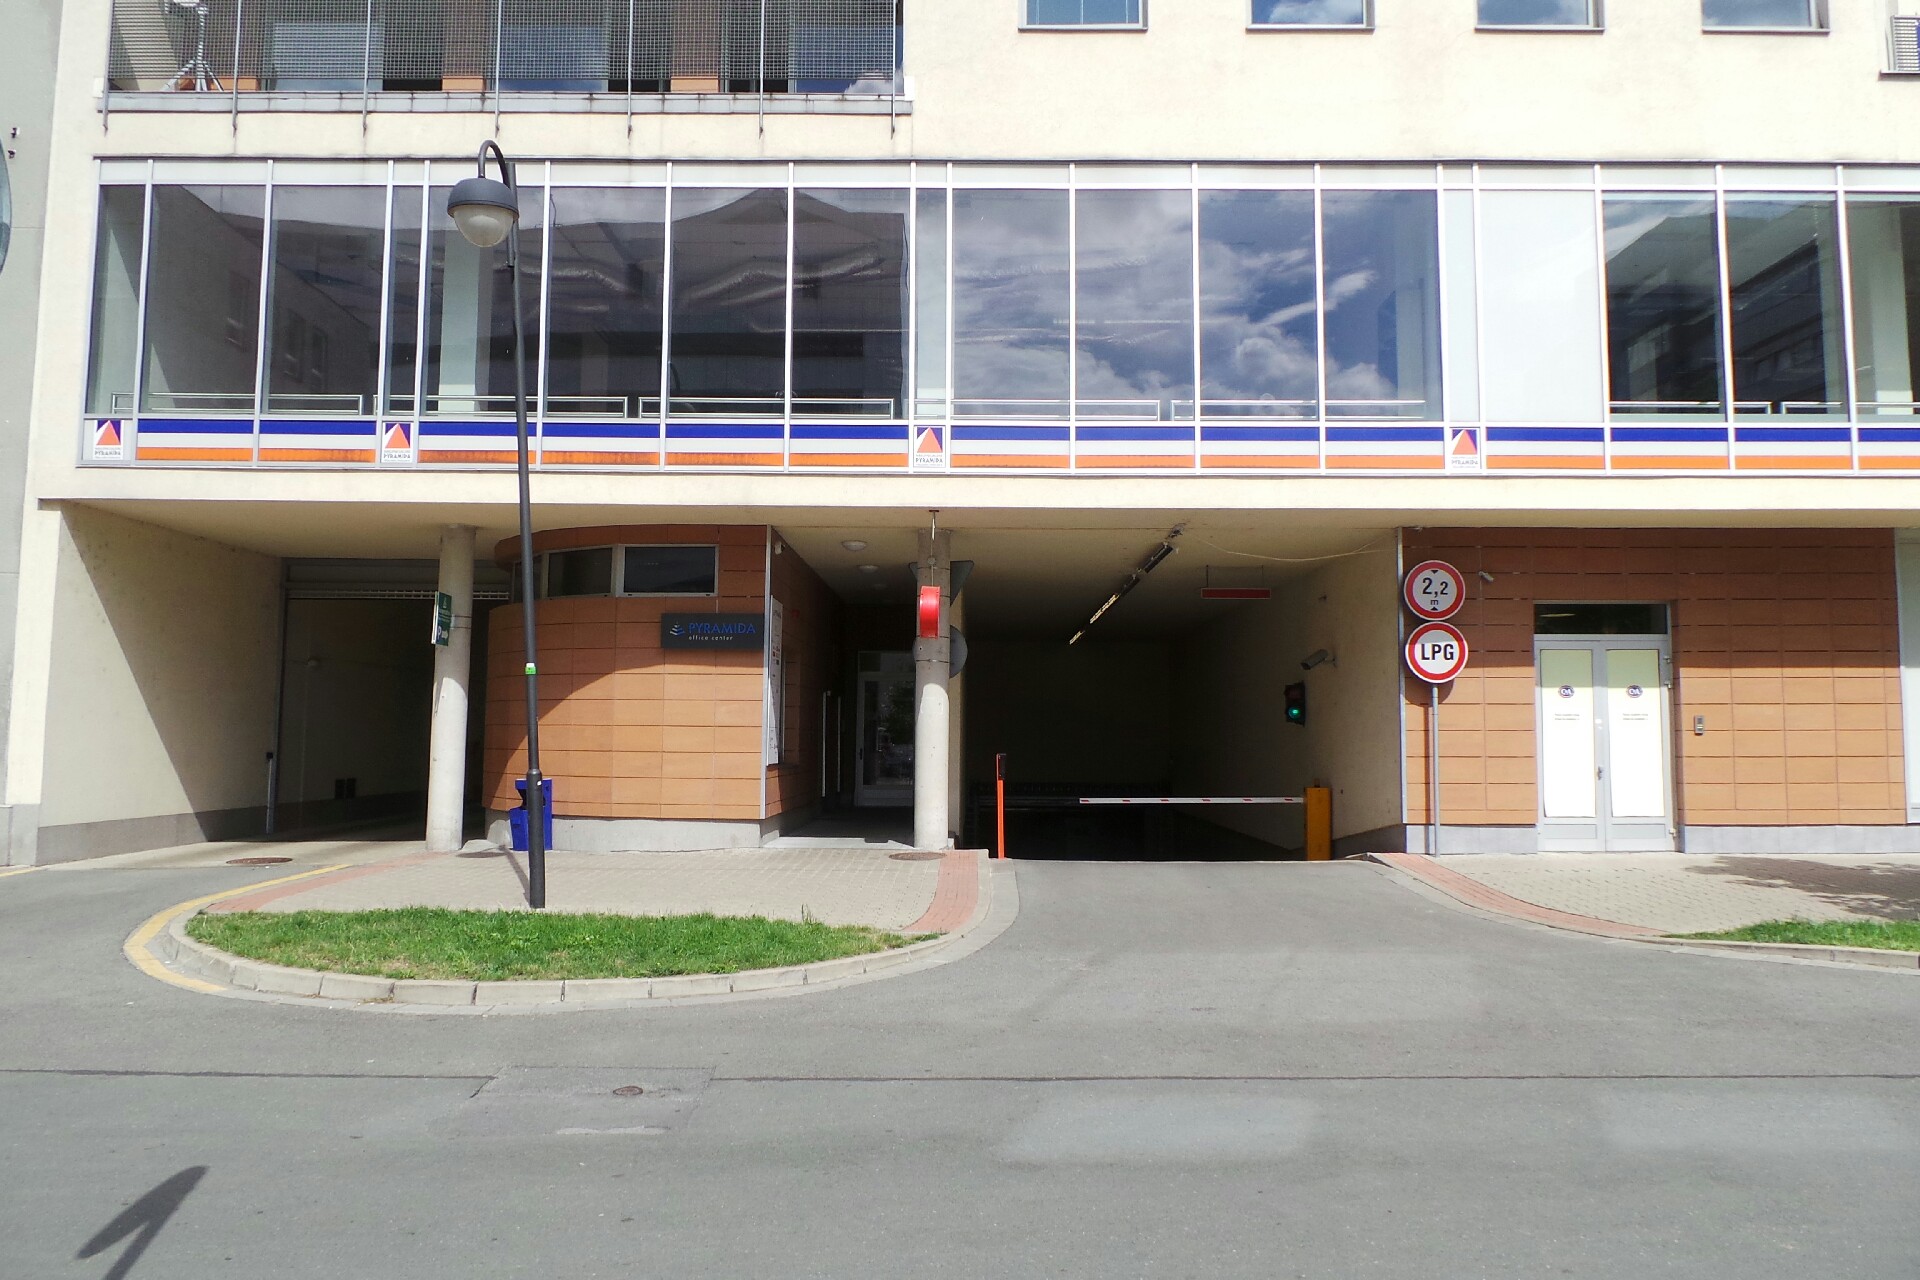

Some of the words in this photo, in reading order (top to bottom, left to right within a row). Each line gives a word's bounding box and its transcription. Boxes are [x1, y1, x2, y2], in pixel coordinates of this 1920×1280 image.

[1422, 577, 1449, 598] 2,2
[688, 622, 756, 634] PYRAMIDA
[1421, 643, 1454, 661] LPG
